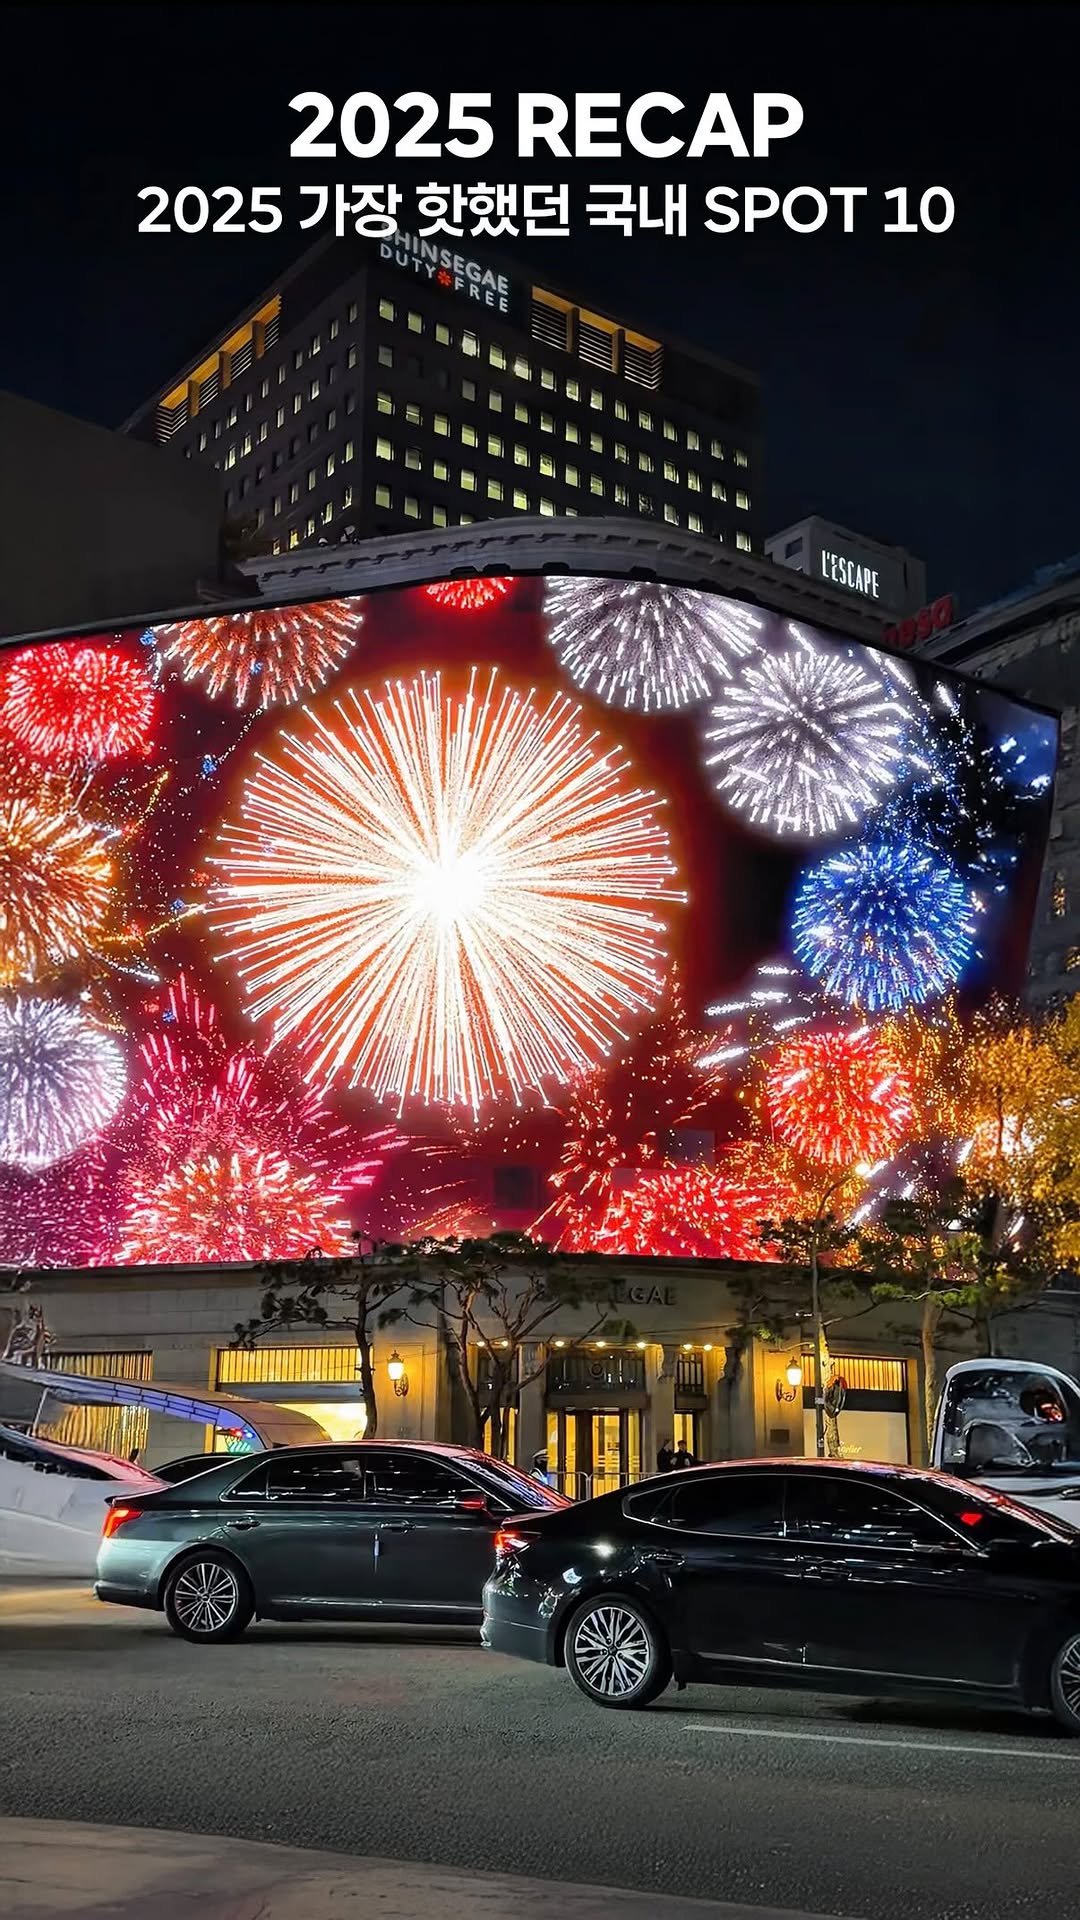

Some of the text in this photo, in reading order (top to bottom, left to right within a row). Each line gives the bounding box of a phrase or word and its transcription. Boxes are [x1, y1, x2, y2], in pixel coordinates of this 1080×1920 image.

[380, 243, 509, 313] DUTY FREE
[822, 550, 879, 598] L'ESCAPE
